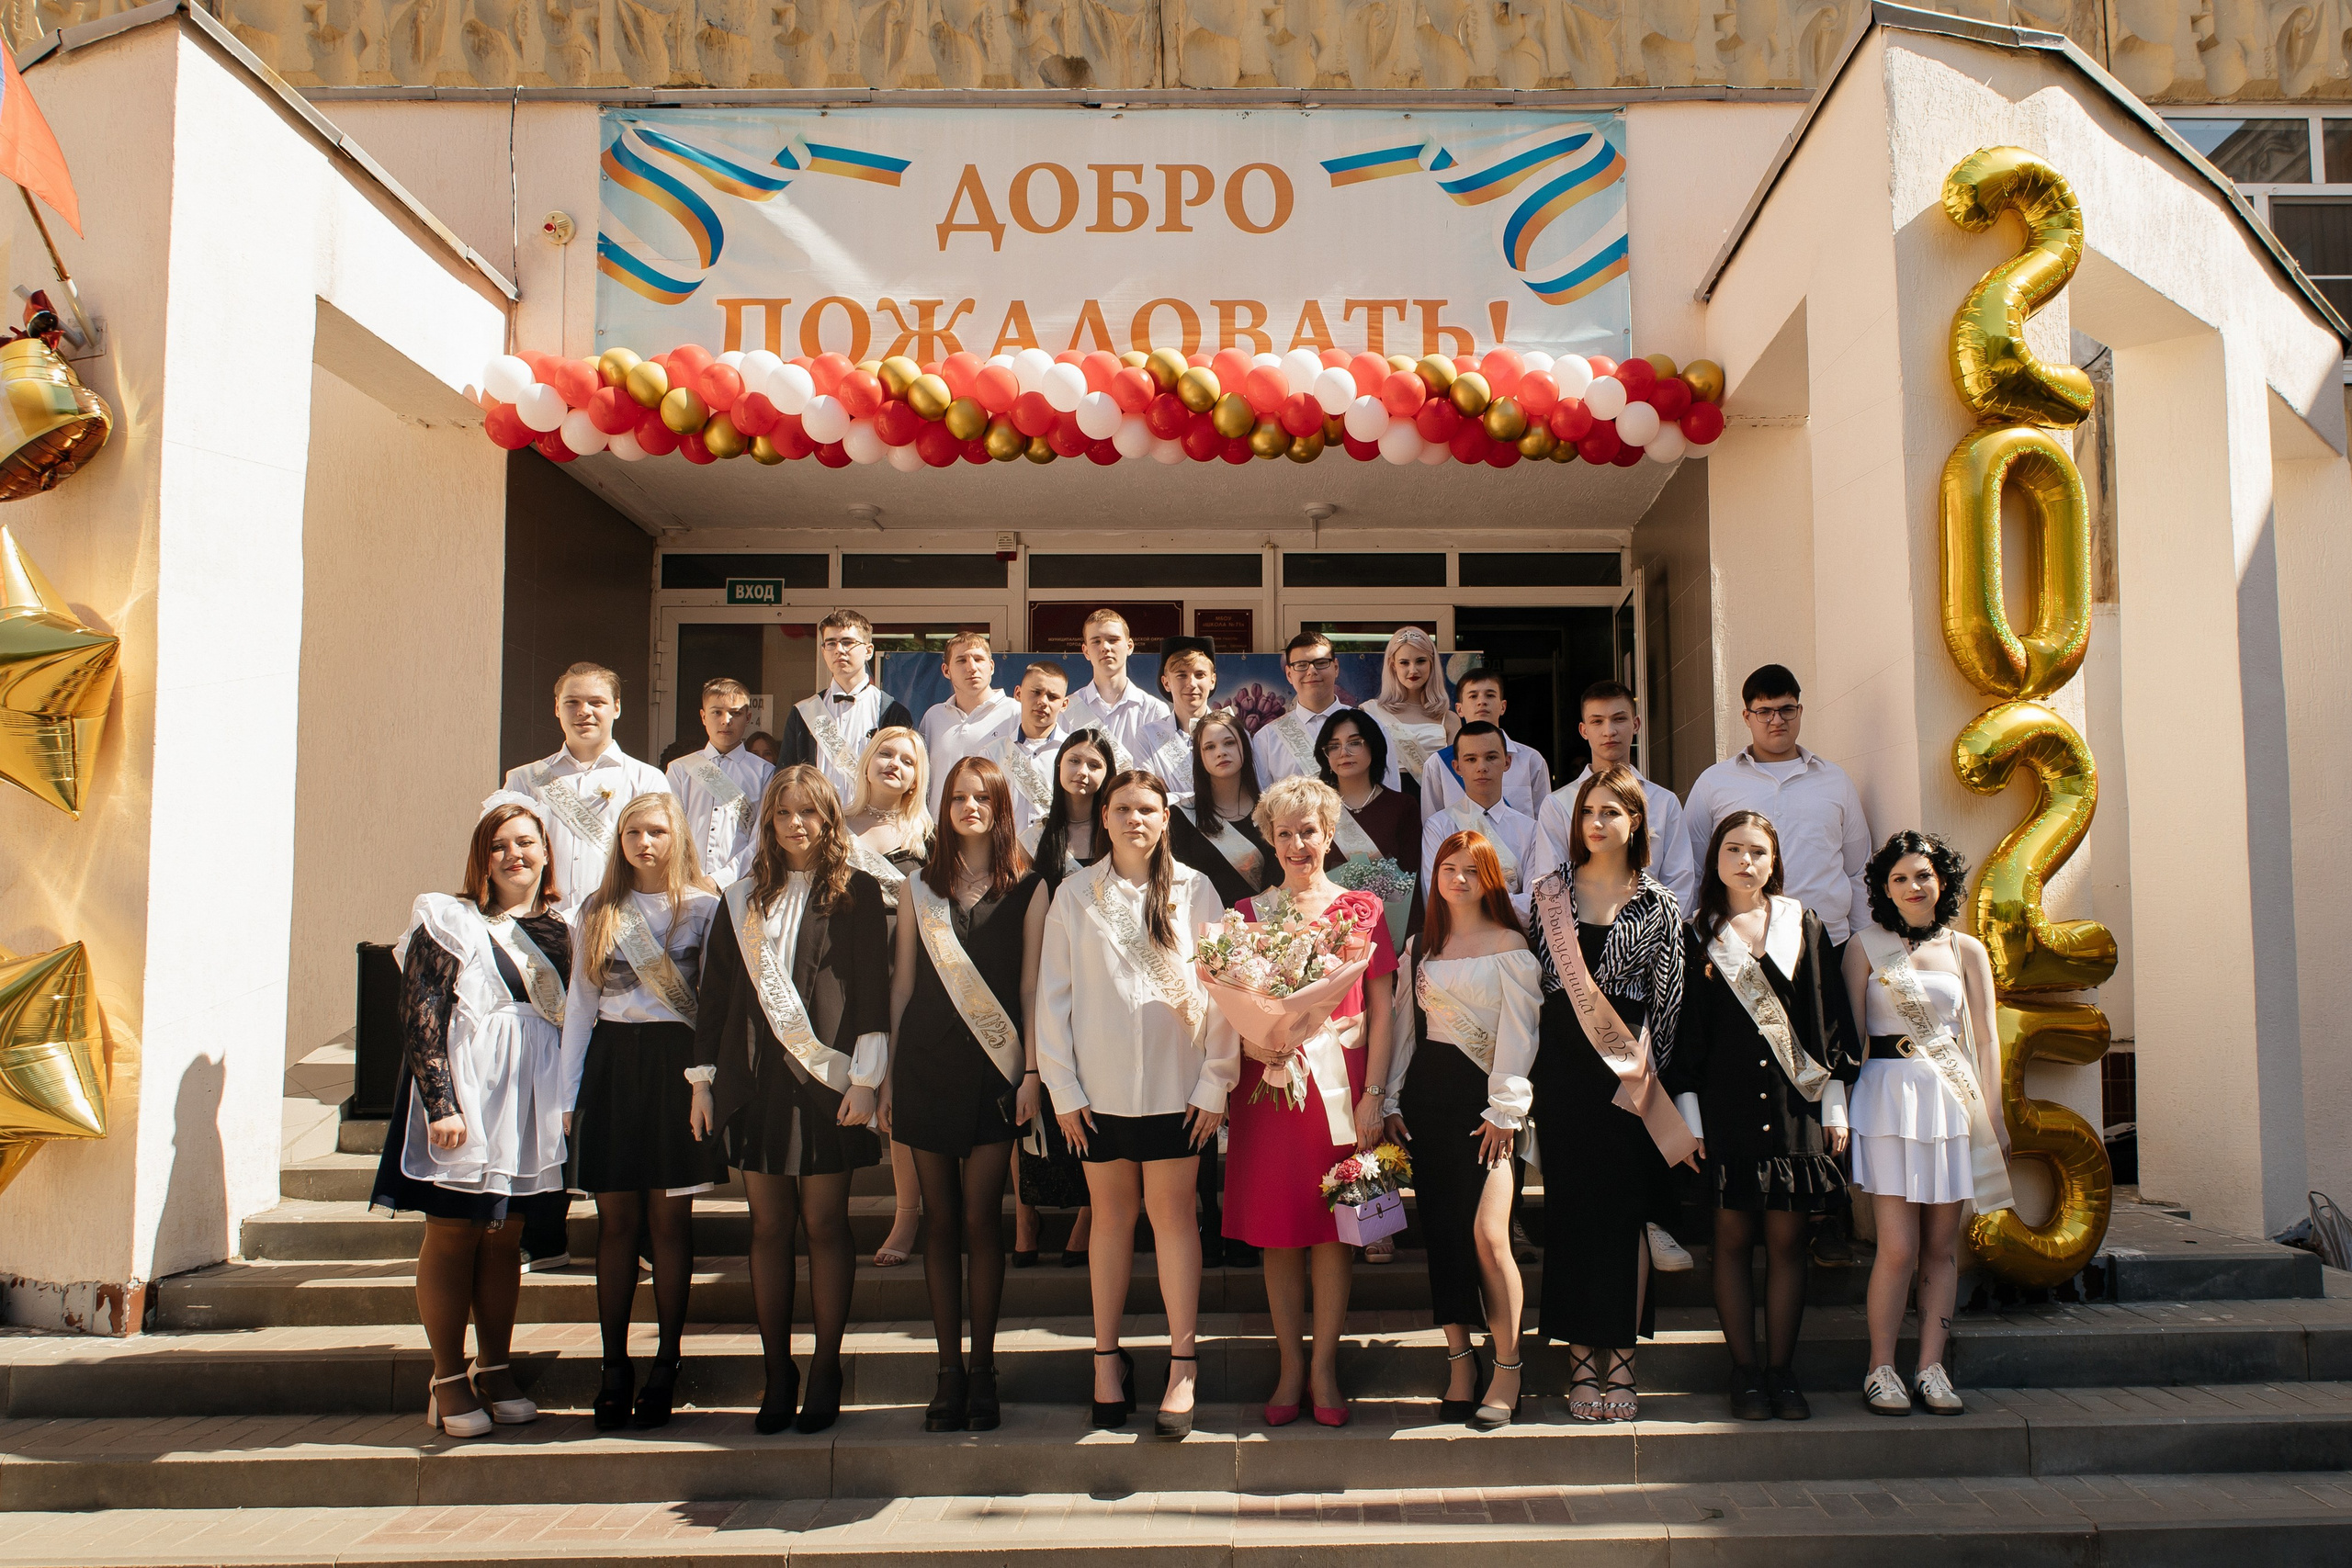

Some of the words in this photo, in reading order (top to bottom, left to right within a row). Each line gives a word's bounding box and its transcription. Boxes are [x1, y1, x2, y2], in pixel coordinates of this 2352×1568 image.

[935, 162, 1295, 252] ДОБРО
[716, 296, 1510, 362] ПОЖАЛОВАТЬ!
[736, 584, 775, 602] ВХОД
[1939, 144, 2118, 1286] 2025
[1160, 977, 1208, 1027] 2025
[1547, 901, 1595, 1016] Выпускница
[1594, 1021, 1635, 1062] 2025
[776, 1013, 820, 1060] 2025
[969, 1001, 1015, 1050] 2025
